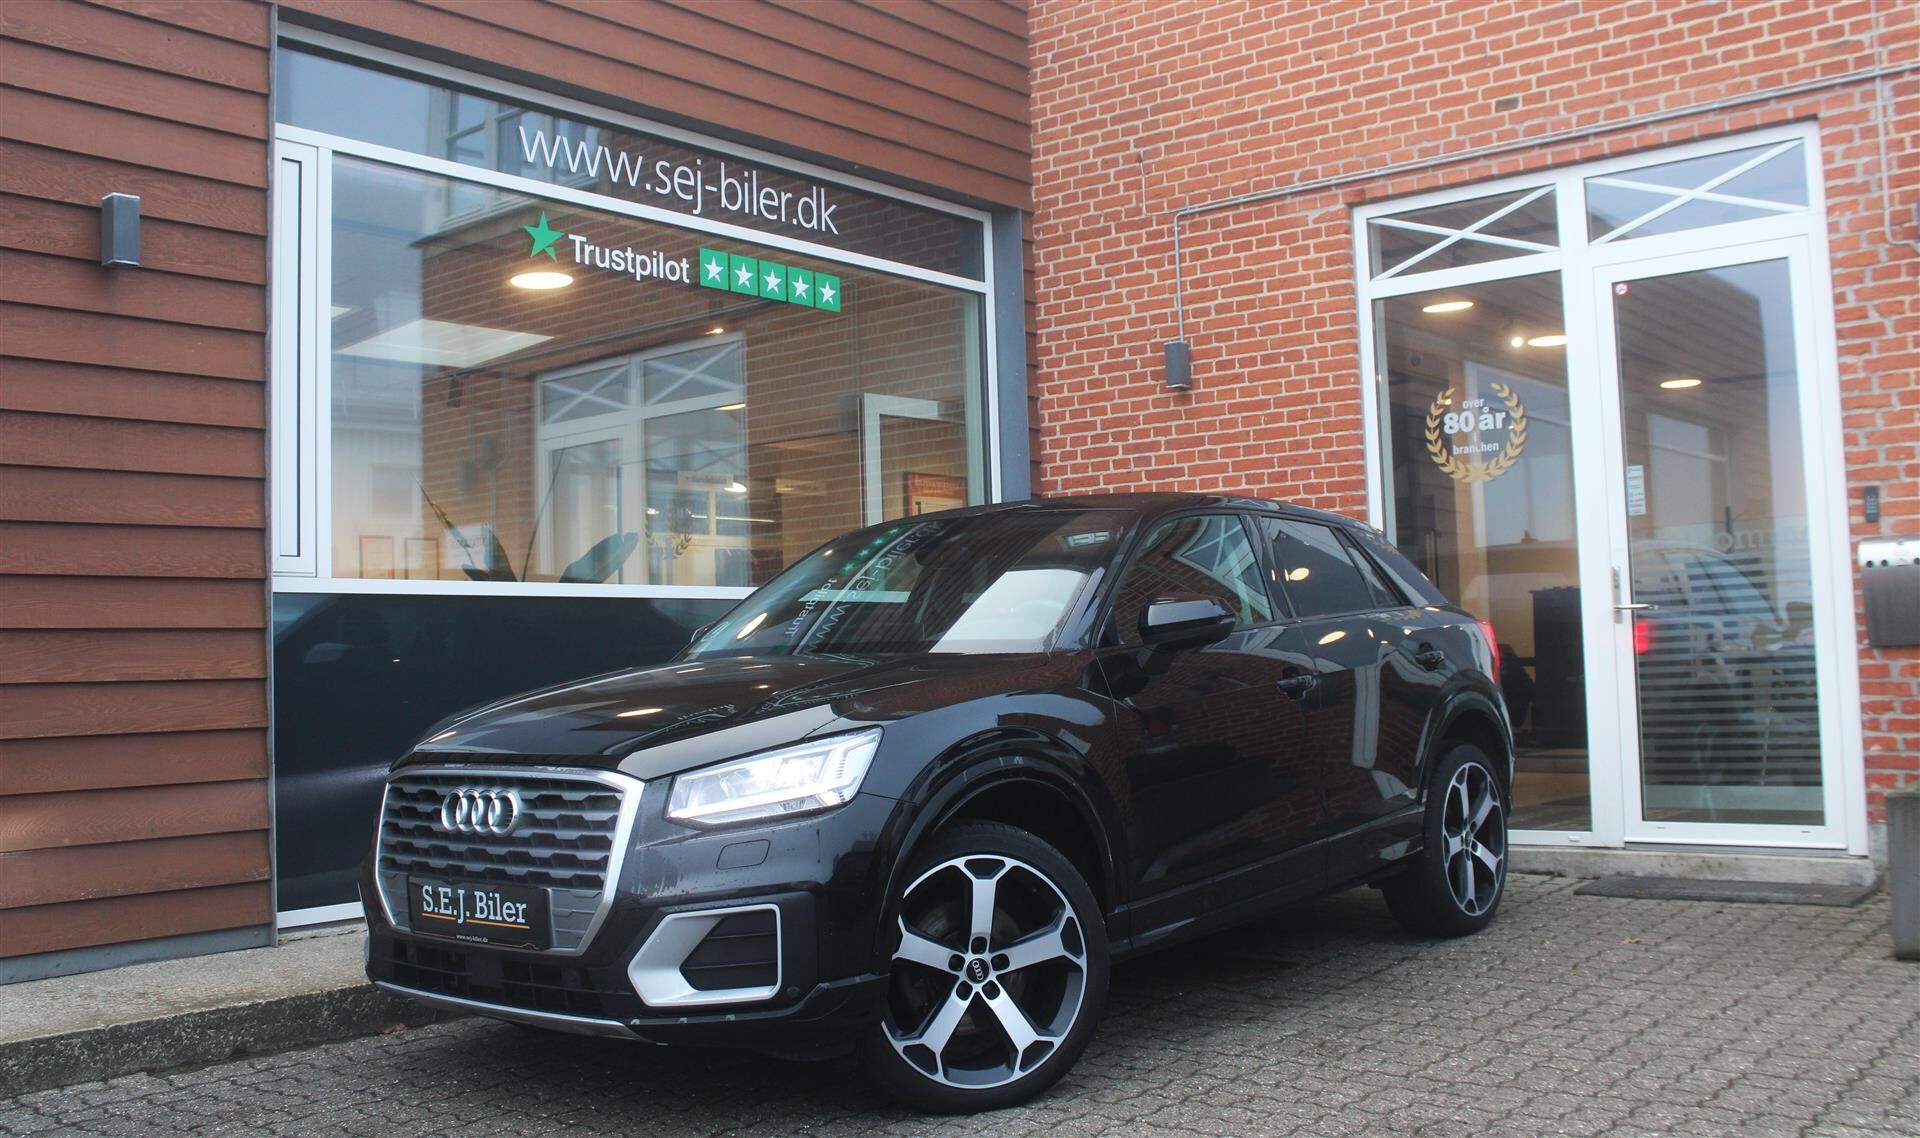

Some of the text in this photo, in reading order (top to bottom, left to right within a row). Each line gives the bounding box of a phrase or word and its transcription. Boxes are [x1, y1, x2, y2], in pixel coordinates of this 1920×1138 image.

[519, 125, 839, 235] www.sej-biler.dk
[568, 234, 691, 284] Trustpilot
[1443, 406, 1506, 434] 80 år
[1462, 399, 1485, 410] over
[422, 885, 527, 923] S.E.J. Biler
